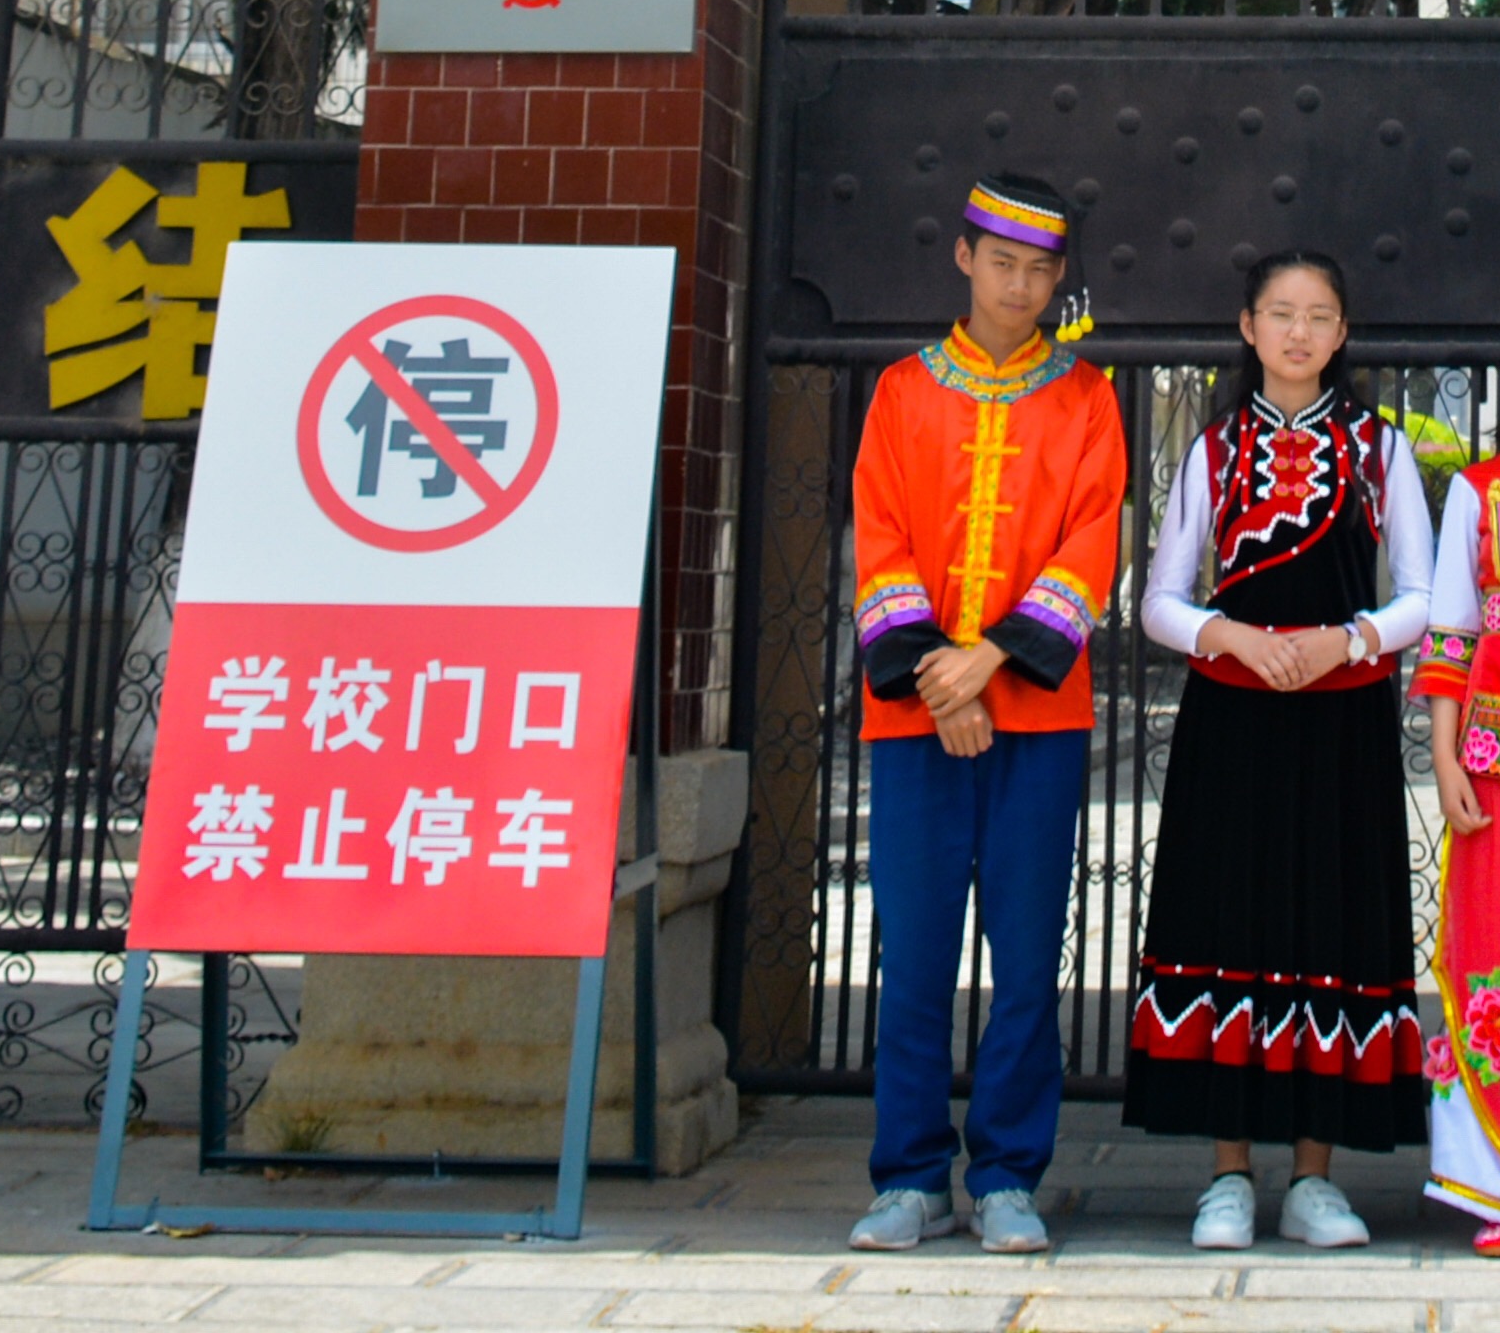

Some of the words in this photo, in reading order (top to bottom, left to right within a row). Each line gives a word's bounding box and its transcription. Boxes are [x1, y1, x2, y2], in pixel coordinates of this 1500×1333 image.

[202, 655, 583, 755] 学校门口
[181, 783, 575, 889] 禁止停车
